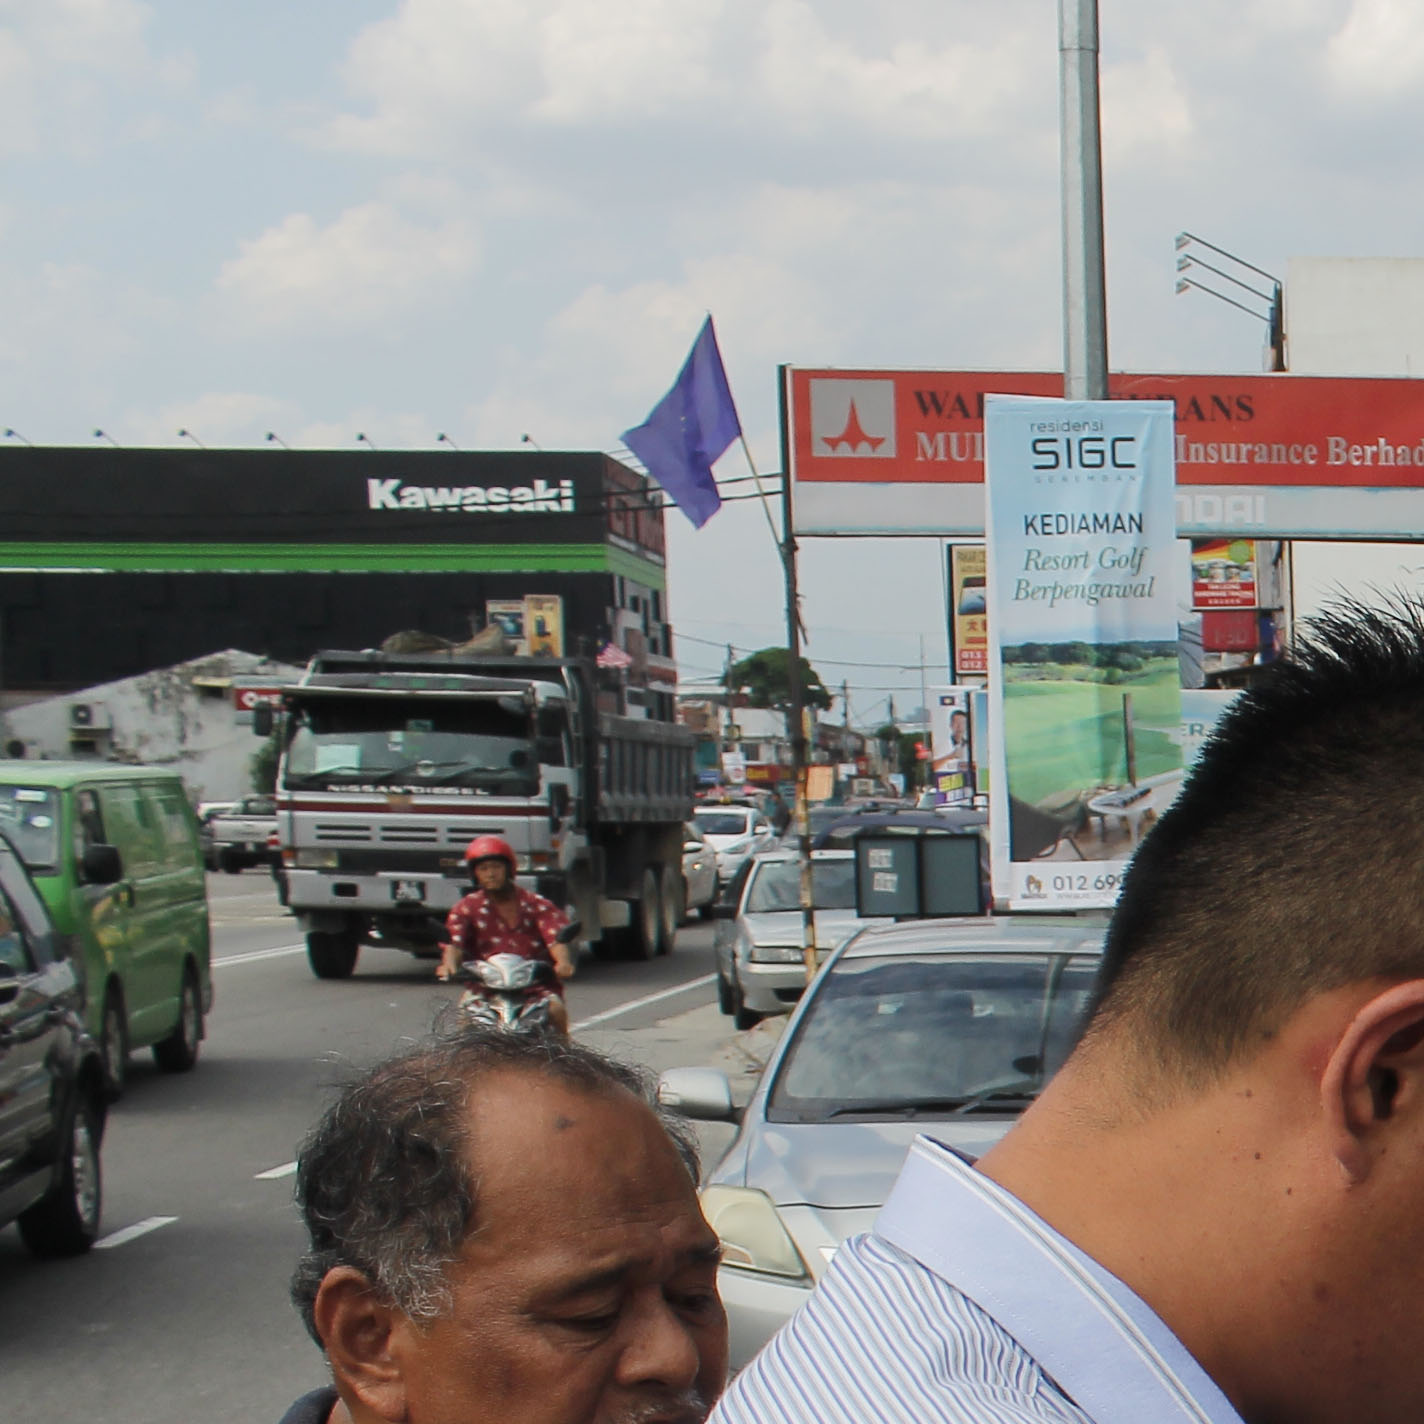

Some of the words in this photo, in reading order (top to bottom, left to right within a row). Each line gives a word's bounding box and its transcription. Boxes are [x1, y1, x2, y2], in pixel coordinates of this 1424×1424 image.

[1030, 420, 1104, 432] residensi
[1032, 437, 1136, 470] SIGC
[1176, 435, 1317, 465] Insurance
[367, 478, 575, 512] Kawasaki
[1024, 513, 1144, 536] KEDIAMAN
[1024, 548, 1089, 572] Resort
[1099, 546, 1148, 576] Golf
[1013, 575, 1156, 608] Berpengawal
[1053, 875, 1088, 891] 012
